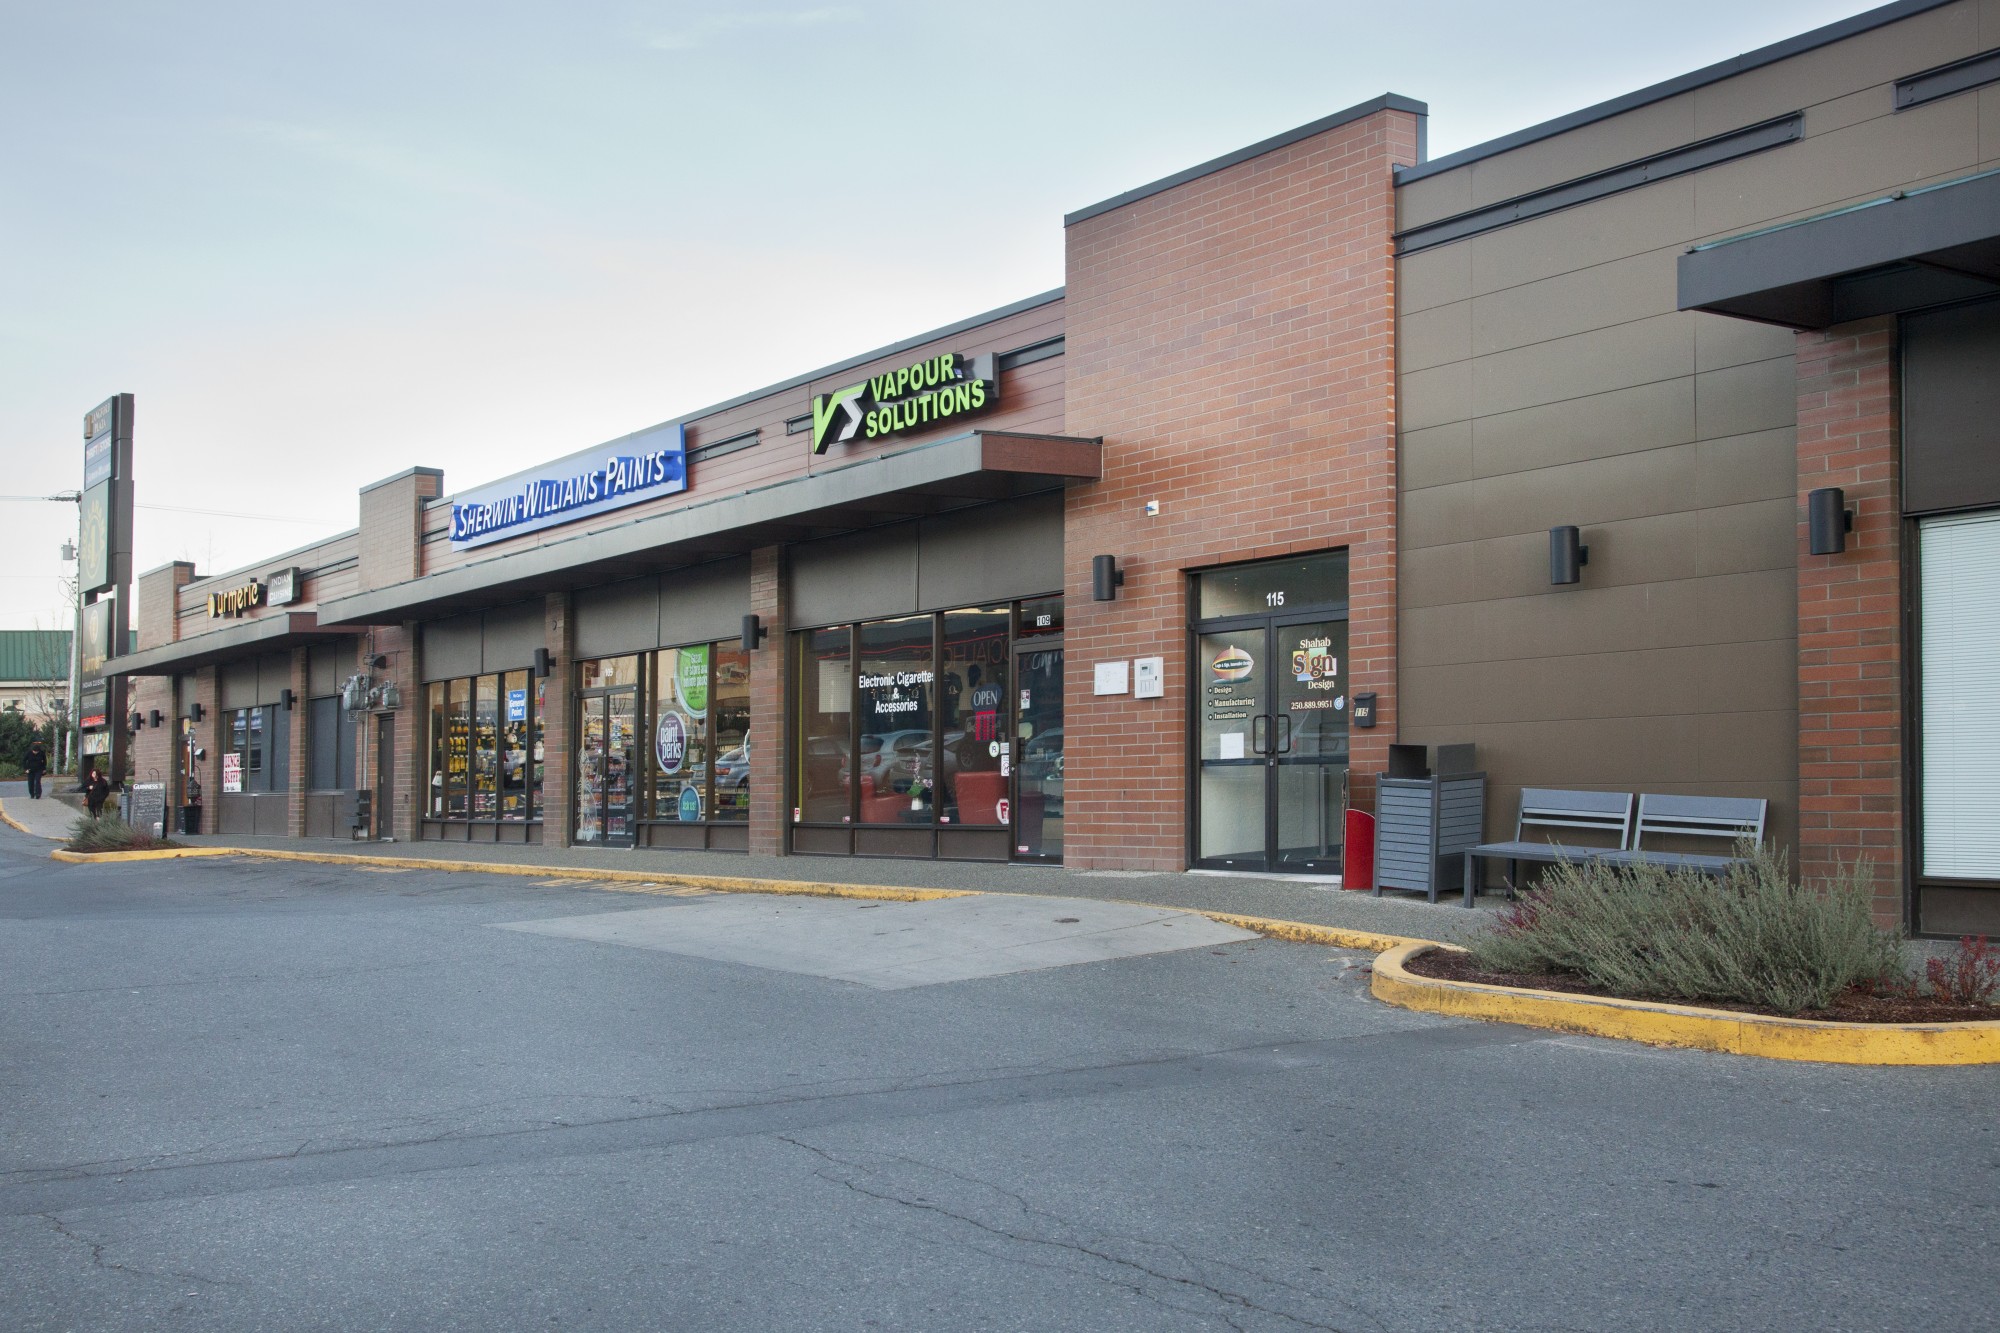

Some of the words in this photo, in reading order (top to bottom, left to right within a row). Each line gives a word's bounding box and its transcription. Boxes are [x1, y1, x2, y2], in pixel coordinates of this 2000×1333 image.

[871, 353, 955, 402] VAPOUR
[866, 379, 985, 438] SOLUTIONS
[458, 471, 598, 537] SHERWIN-WILLIAMS
[604, 450, 665, 495] PAINTS
[271, 574, 291, 587] INDIAN
[269, 587, 292, 602] CUISINE
[1266, 591, 1285, 606] 115
[1037, 615, 1050, 626] 109
[1300, 636, 1331, 648] Shahab
[1292, 651, 1334, 679] Sign
[859, 672, 895, 688] Electronic
[1308, 679, 1335, 690] Design
[893, 687, 900, 699] &
[1214, 686, 1232, 694] Design
[973, 689, 998, 707] OPEN
[1214, 697, 1255, 707] Manufacturing
[1290, 700, 1332, 710] 250.889.9951
[875, 698, 918, 714] Accessories
[1355, 708, 1369, 717] 115
[1214, 711, 1247, 720] Installation
[660, 723, 679, 746] paint
[662, 740, 682, 762] perks
